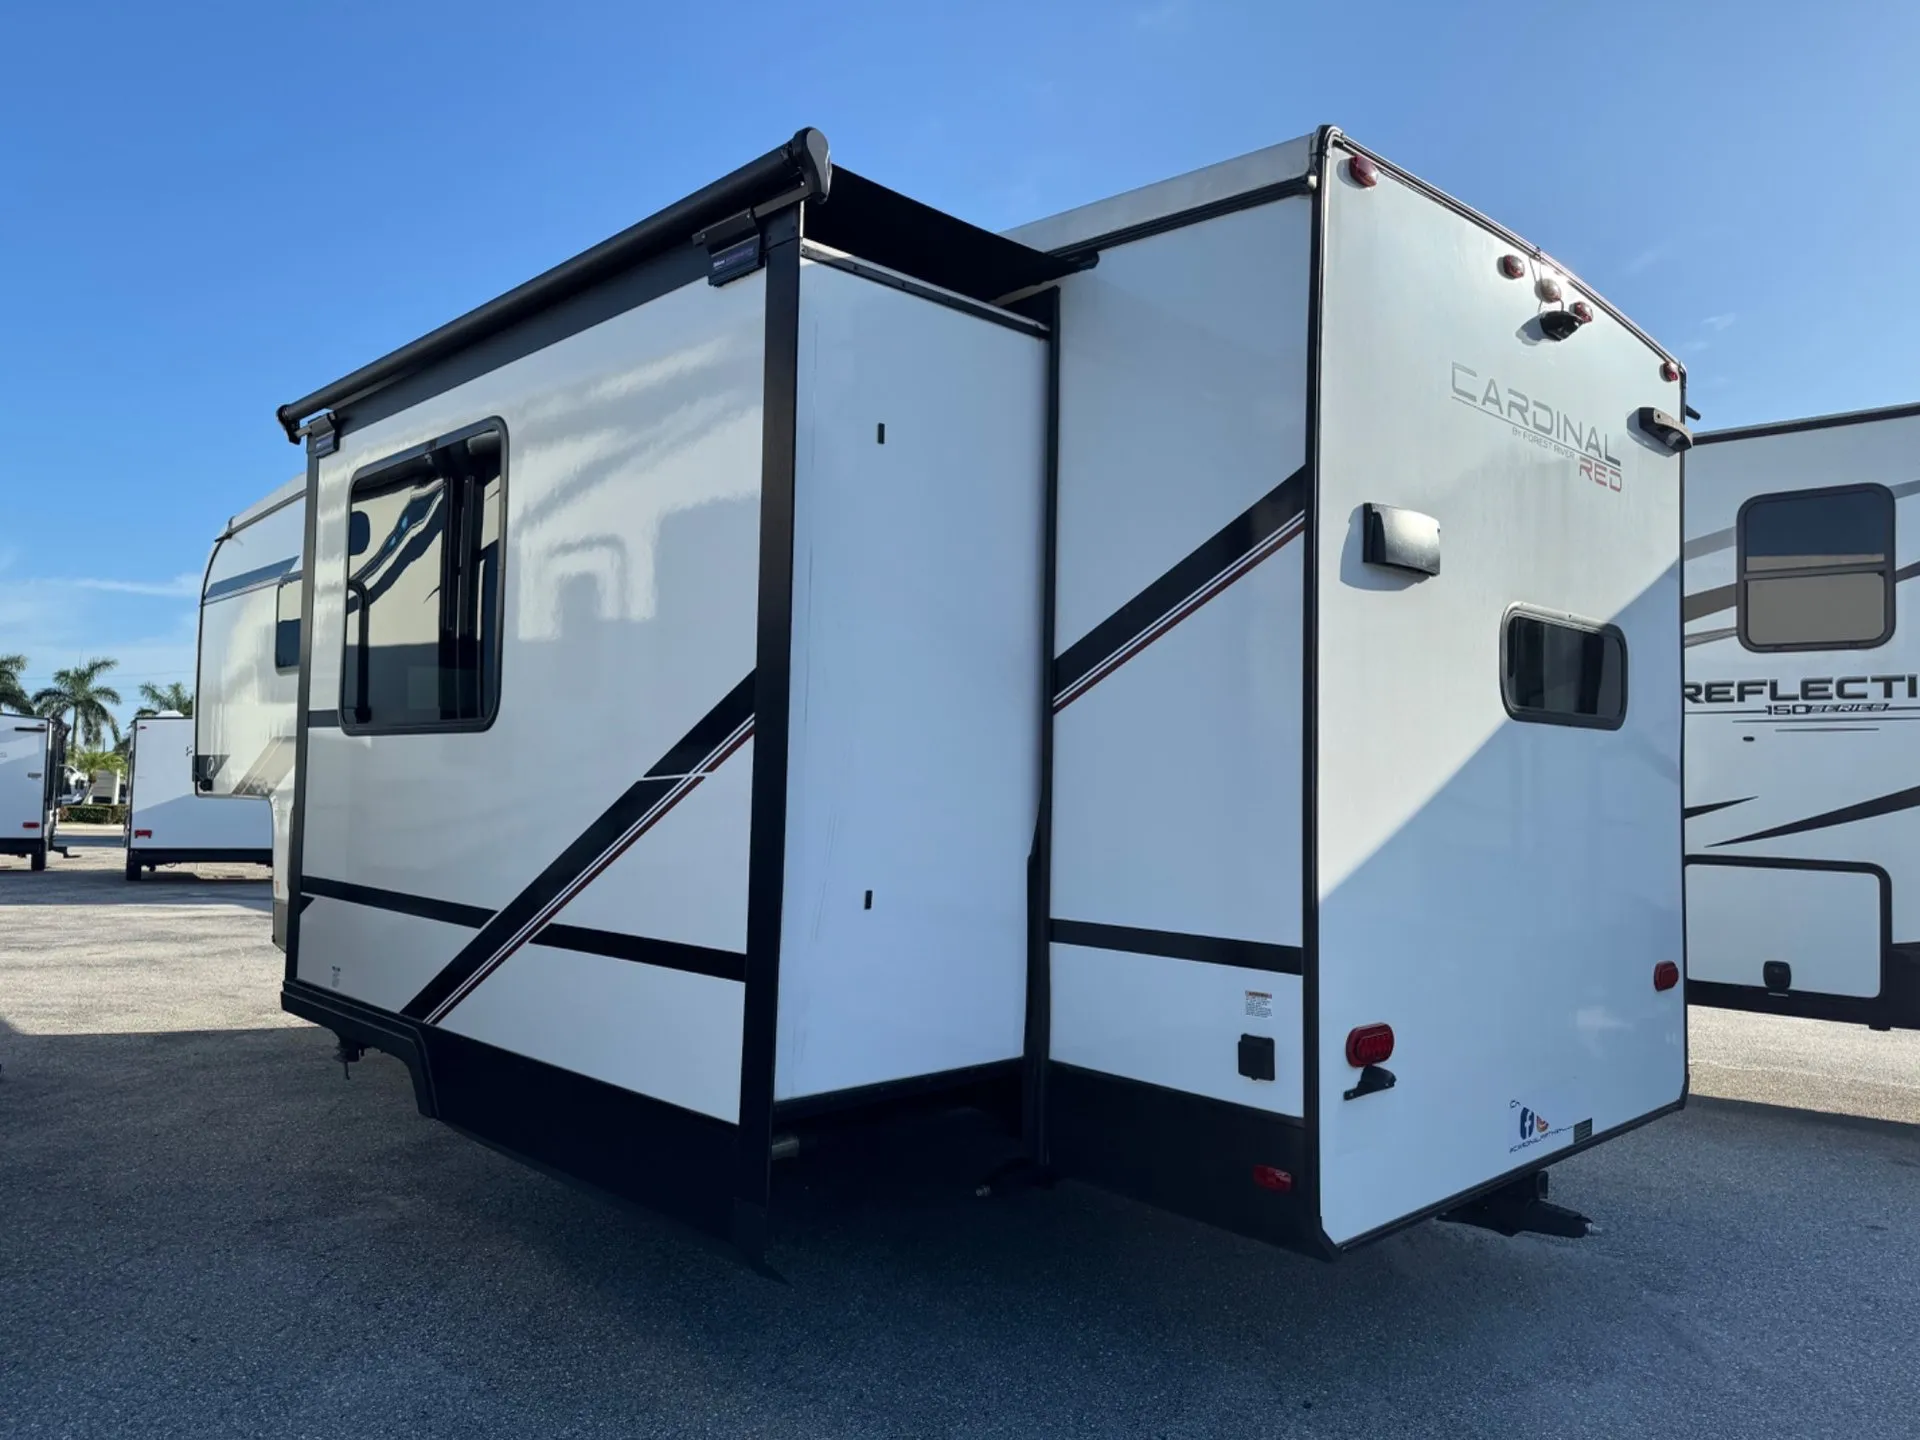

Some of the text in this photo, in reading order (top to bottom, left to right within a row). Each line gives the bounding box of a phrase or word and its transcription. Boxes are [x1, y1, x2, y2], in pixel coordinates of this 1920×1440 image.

[1451, 361, 1621, 467] CARDINAL
[1522, 430, 1553, 449] FOREST
[1553, 443, 1576, 461] RIVER
[1579, 457, 1622, 492] RED
